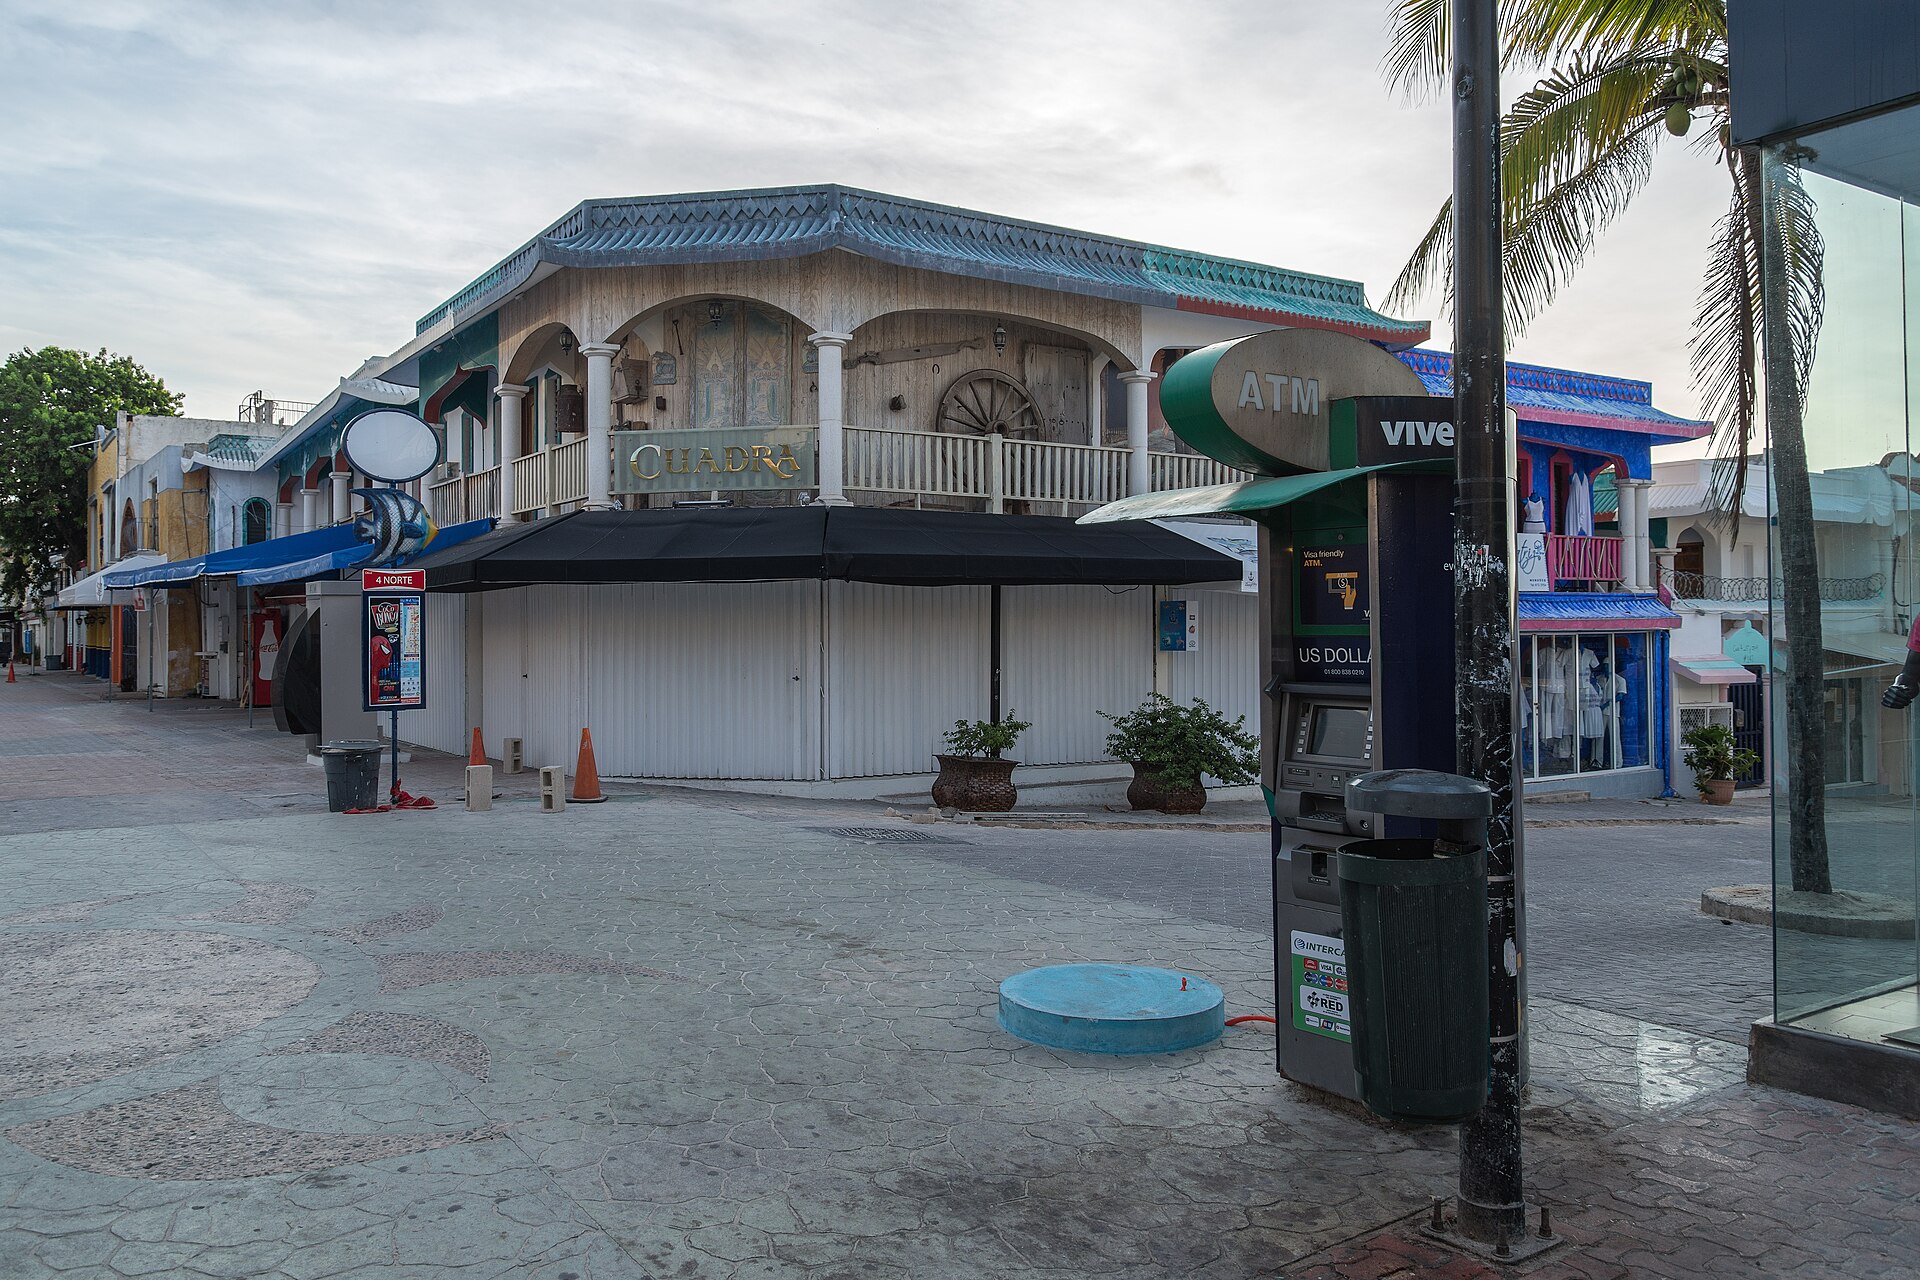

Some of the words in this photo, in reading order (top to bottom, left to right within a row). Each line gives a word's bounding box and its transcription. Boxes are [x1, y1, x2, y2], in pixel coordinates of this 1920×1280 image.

[1237, 370, 1319, 416] ATM
[629, 444, 801, 480] CUADRA
[1303, 550, 1318, 558] Visa
[1318, 549, 1345, 558] friendly
[375, 576, 382, 585] 4
[383, 576, 413, 585] NORTE
[1299, 647, 1321, 664] US
[1320, 964, 1332, 972] VISA
[1321, 998, 1343, 1012] RED
